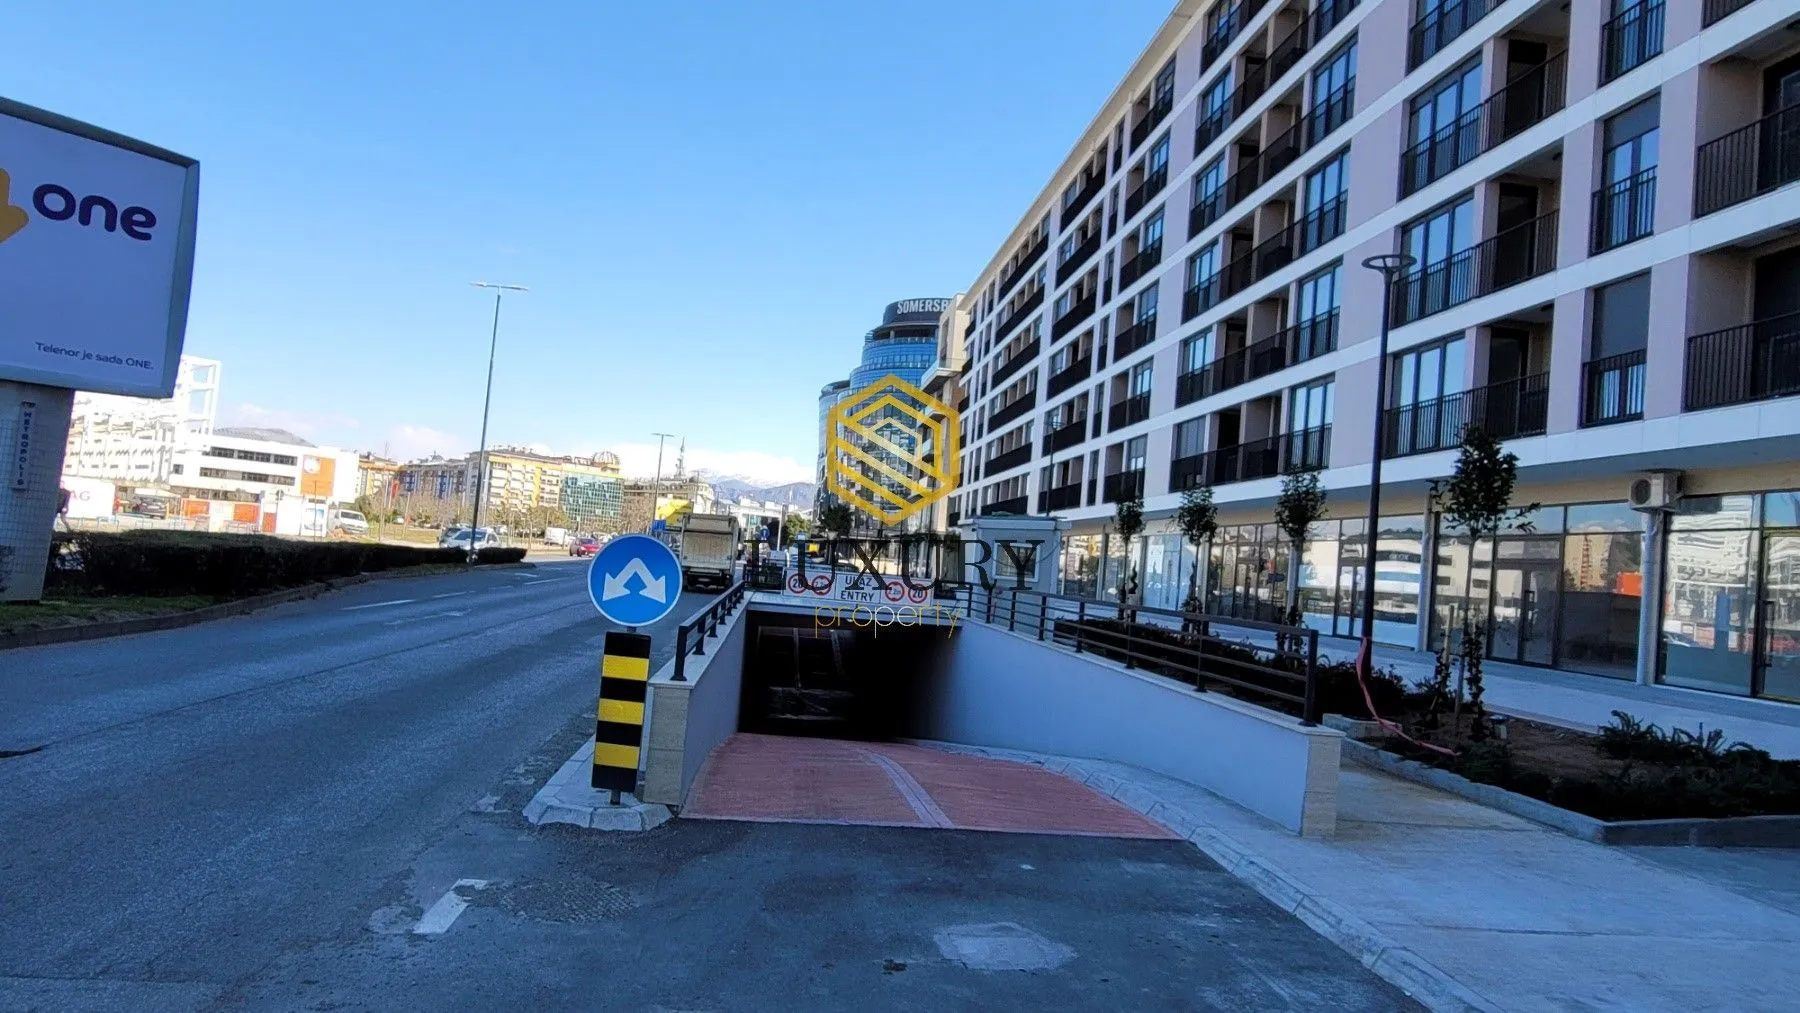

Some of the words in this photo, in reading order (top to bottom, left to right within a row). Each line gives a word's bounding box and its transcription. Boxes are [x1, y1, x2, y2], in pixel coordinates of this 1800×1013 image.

[32, 183, 157, 241] one
[35, 341, 80, 358] Telenor
[81, 350, 93, 360] je
[95, 353, 123, 365] sada
[125, 357, 154, 370] ONE.
[17, 411, 32, 485] METROPOLIS
[841, 590, 875, 602] ENTRY
[912, 588, 924, 599] 20
